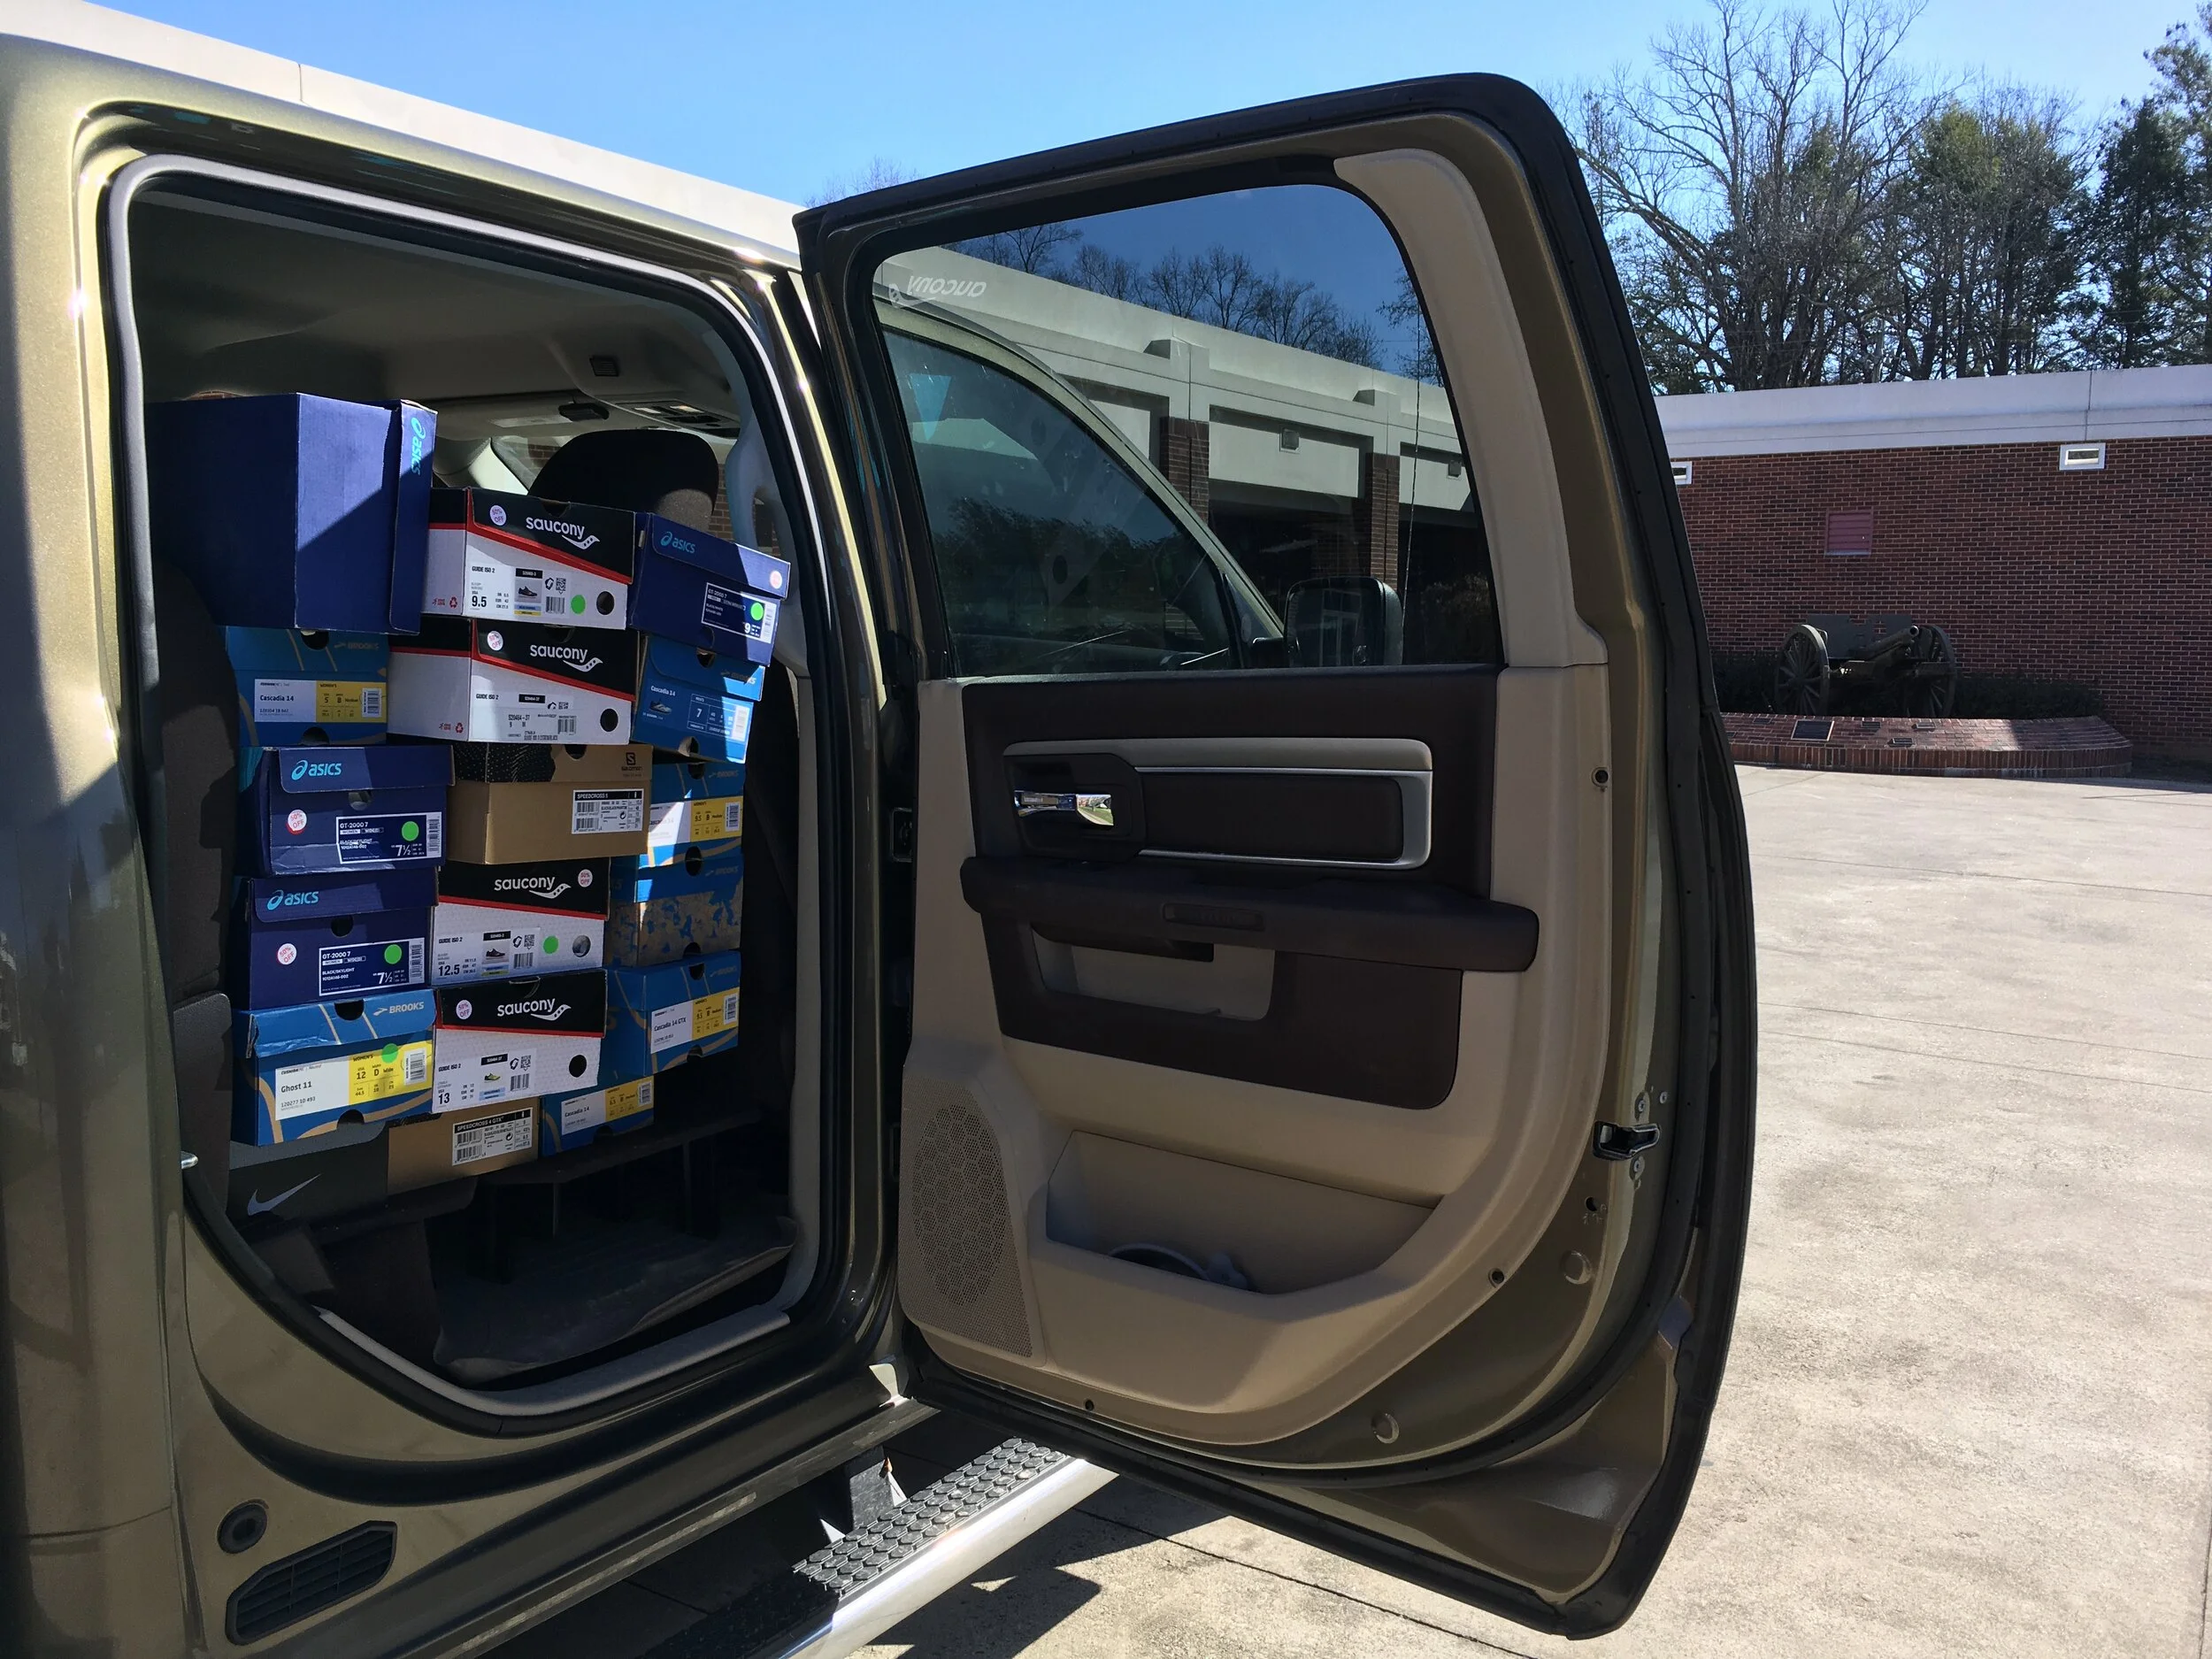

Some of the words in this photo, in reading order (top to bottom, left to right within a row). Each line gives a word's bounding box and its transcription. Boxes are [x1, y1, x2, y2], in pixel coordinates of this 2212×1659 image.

[411, 436, 422, 475] asics
[526, 517, 585, 540] saucony
[672, 537, 696, 554] asics
[472, 595, 488, 608] 9.5
[744, 622, 751, 634] 9
[530, 644, 588, 663] saucony
[696, 708, 703, 718] 7
[308, 763, 342, 777] asics
[289, 811, 303, 820] 50%
[292, 819, 304, 829] OFF
[494, 877, 556, 891] saucony
[284, 891, 319, 906] asics
[279, 947, 291, 957] 50%
[283, 951, 295, 964] OFF
[438, 964, 460, 976] 12.5
[389, 1002, 425, 1014] BROOKS
[497, 998, 556, 1017] saucony
[654, 1021, 672, 1032] Cascadia
[280, 1083, 302, 1093] Ghost
[280, 1099, 299, 1108] 120277
[438, 1093, 450, 1104] 13
[565, 1109, 583, 1118] Cascadia
[457, 1120, 488, 1132] SPEEDCROSS
